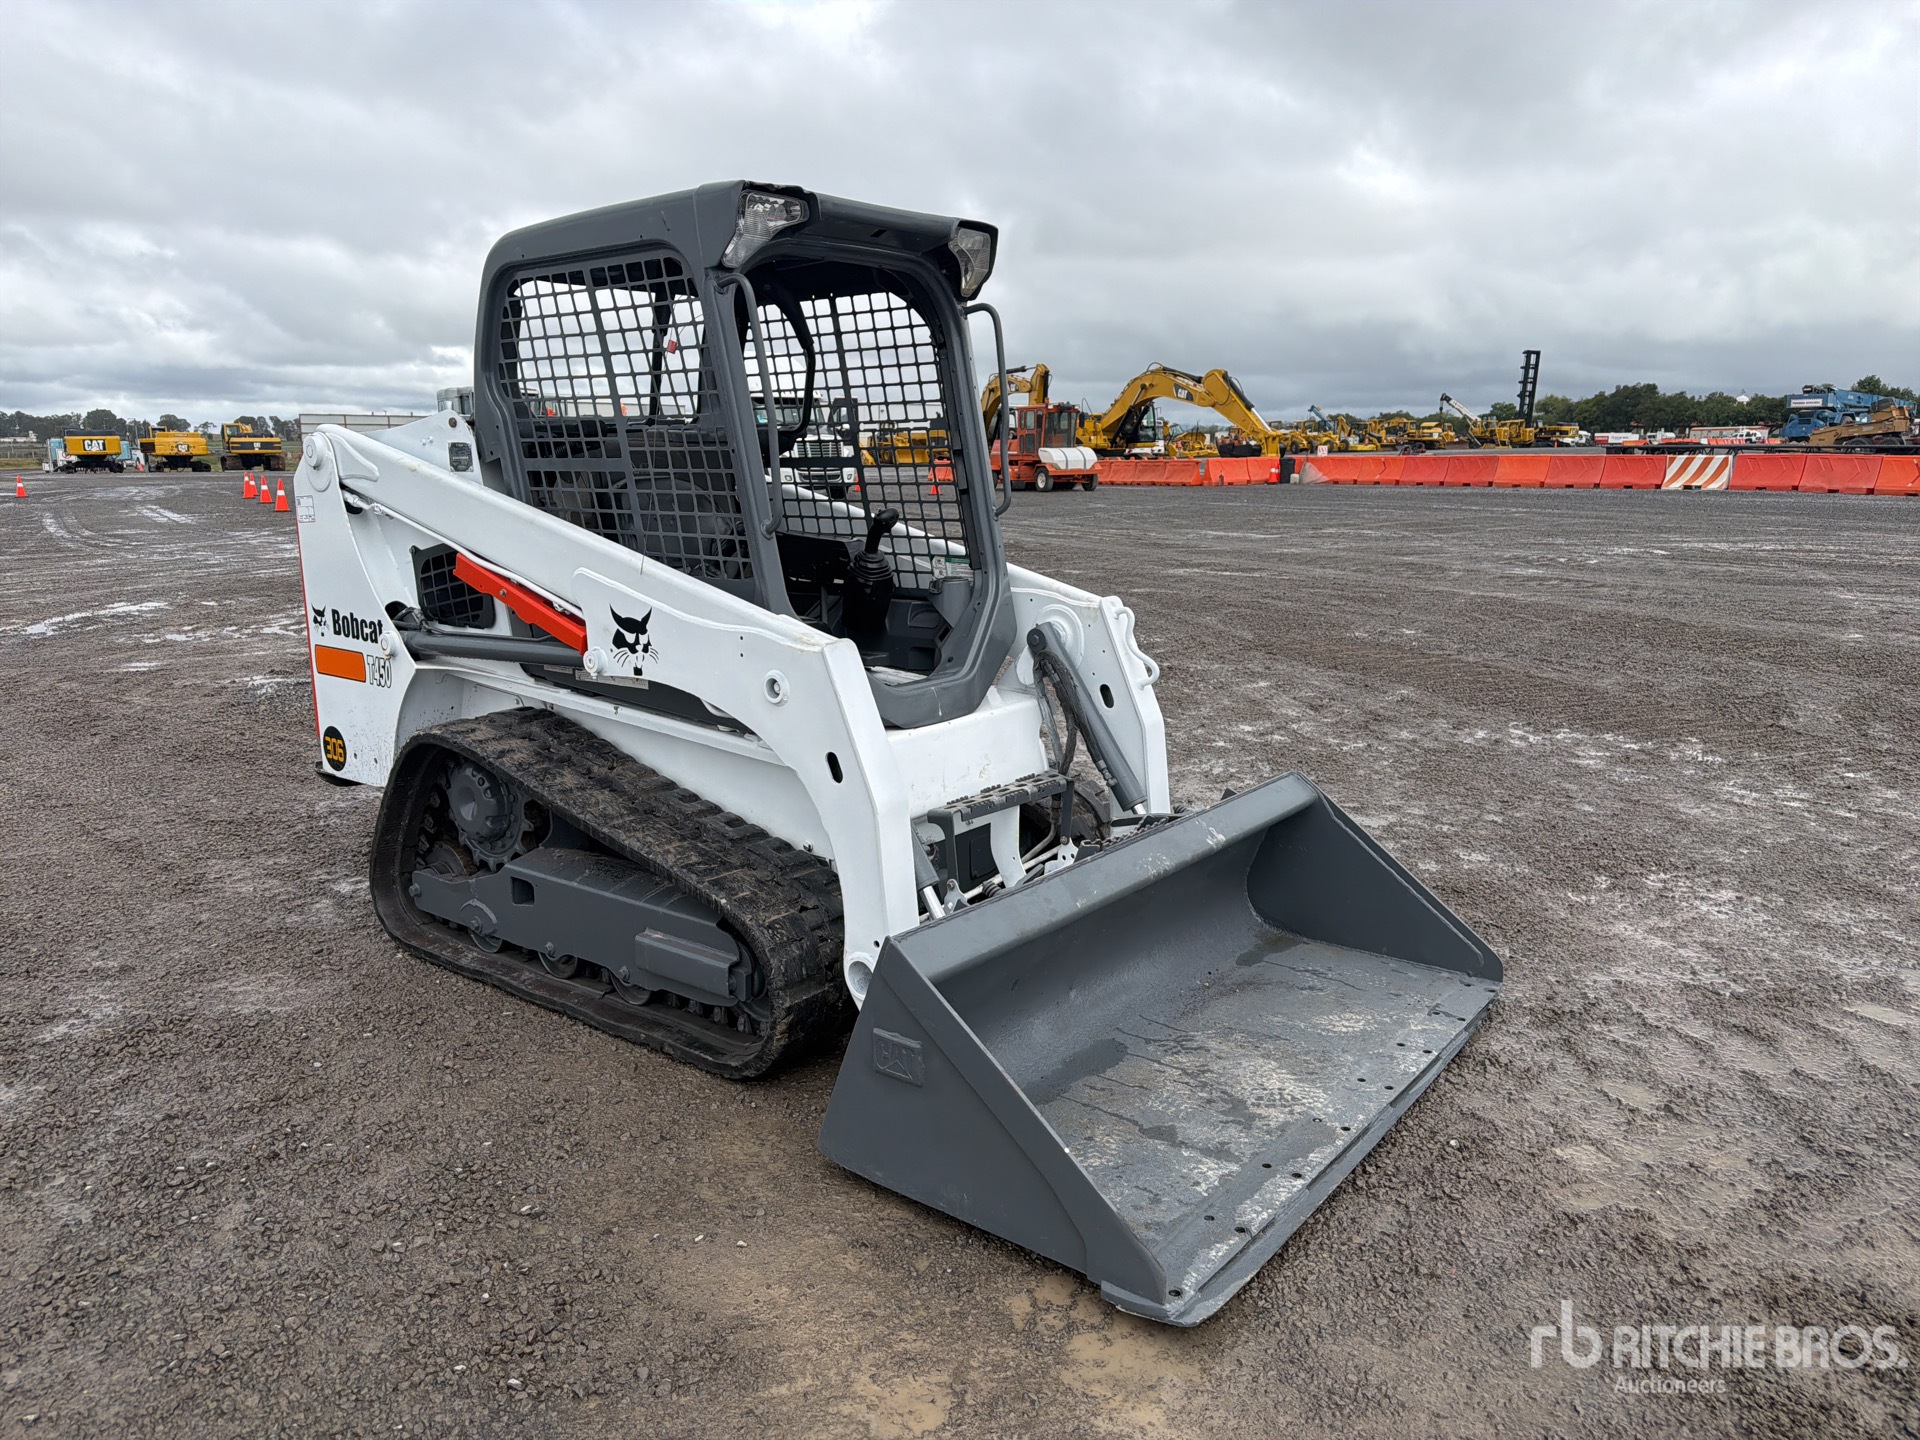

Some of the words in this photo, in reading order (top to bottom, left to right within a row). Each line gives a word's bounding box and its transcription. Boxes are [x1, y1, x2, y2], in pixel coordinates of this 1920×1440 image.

[1177, 388, 1189, 399] CAT
[84, 439, 104, 451] CAT
[331, 608, 383, 644] Bobcat
[366, 654, 392, 689] T450
[324, 735, 345, 763] 306
